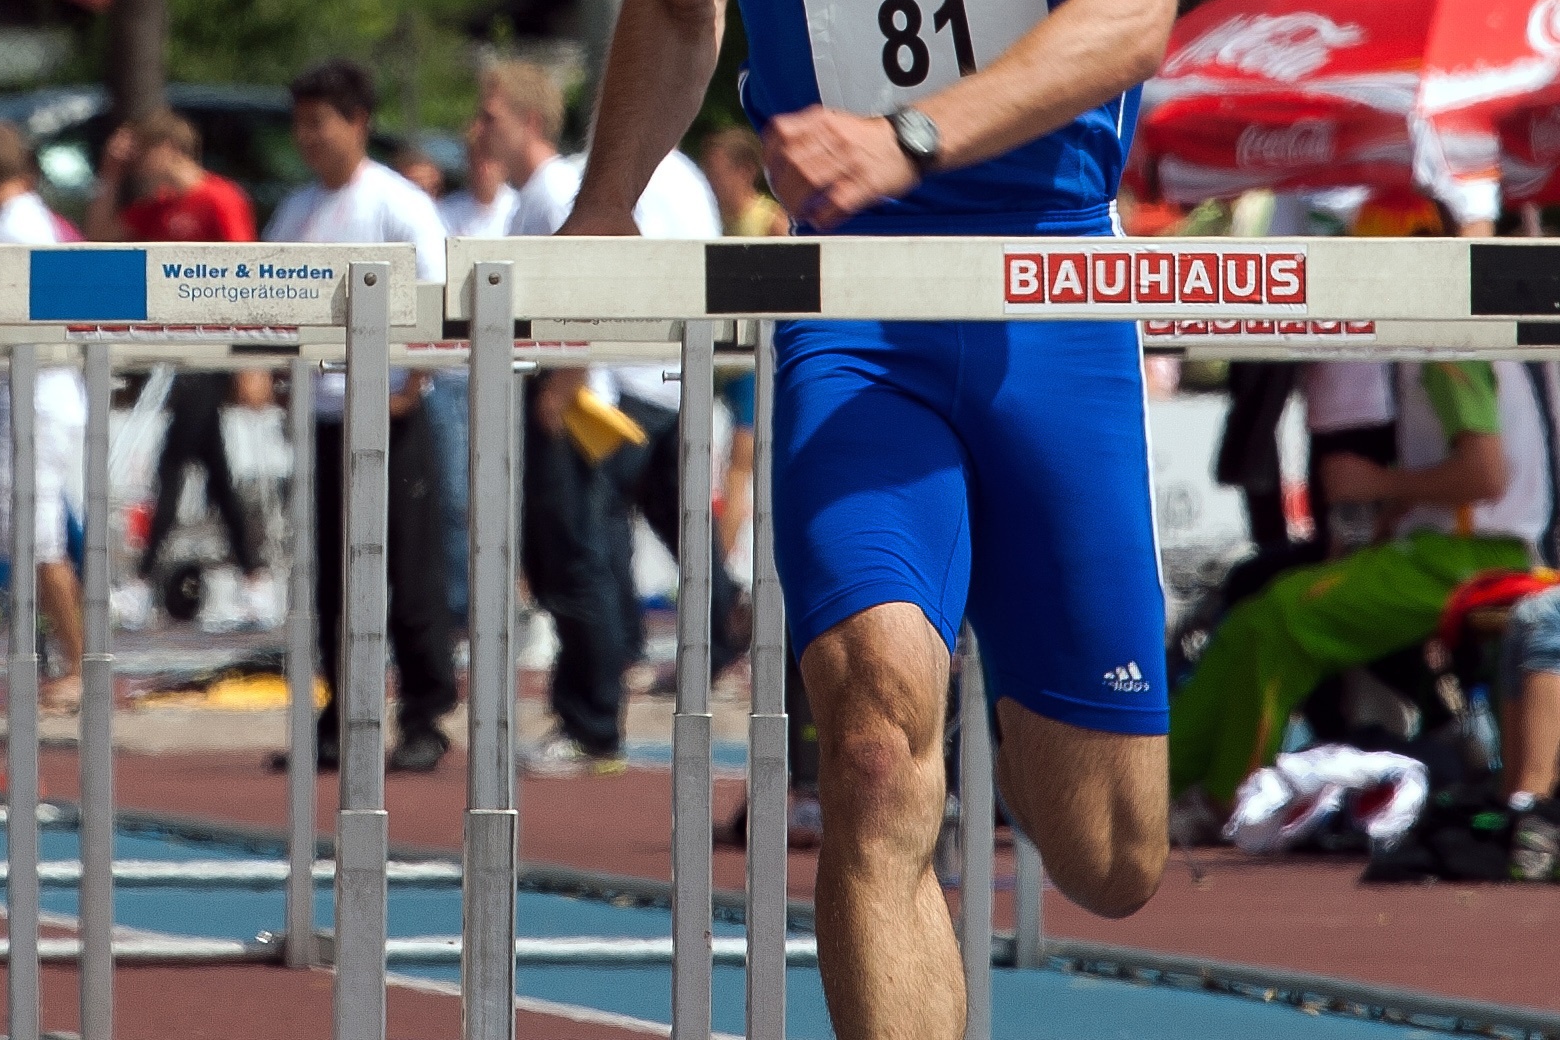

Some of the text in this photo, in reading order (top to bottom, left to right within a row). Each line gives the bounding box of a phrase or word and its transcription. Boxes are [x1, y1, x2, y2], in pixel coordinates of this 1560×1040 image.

[163, 264, 333, 279] Weller & Herden
[1009, 259, 1301, 296] BAUHAUS
[178, 283, 320, 302] Sportgerätebau
